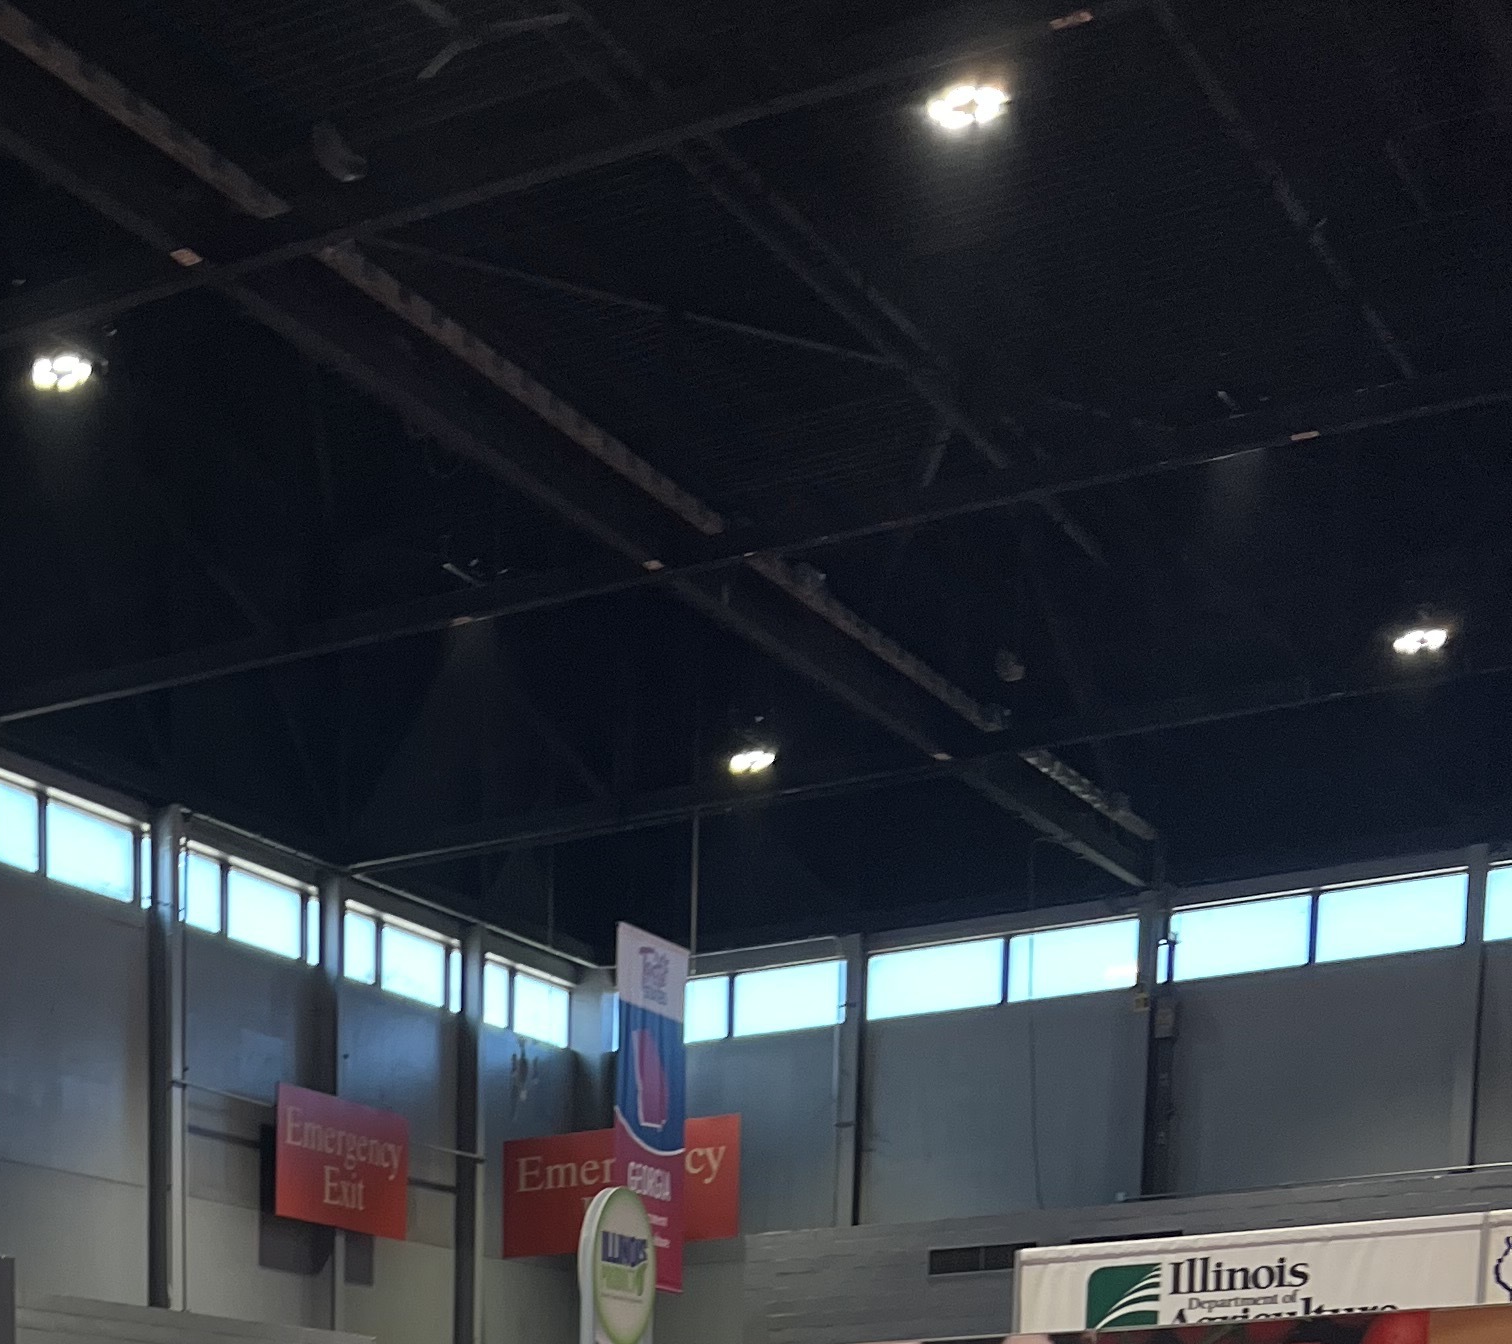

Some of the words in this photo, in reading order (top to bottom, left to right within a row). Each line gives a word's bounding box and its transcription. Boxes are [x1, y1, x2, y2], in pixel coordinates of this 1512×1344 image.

[285, 1104, 403, 1182] Emergency
[323, 1164, 365, 1211] Exit
[516, 1146, 727, 1193] Emercy
[1168, 1256, 1311, 1296] Illinois
[1187, 1293, 1278, 1312] Department
[1281, 1289, 1300, 1304] of
